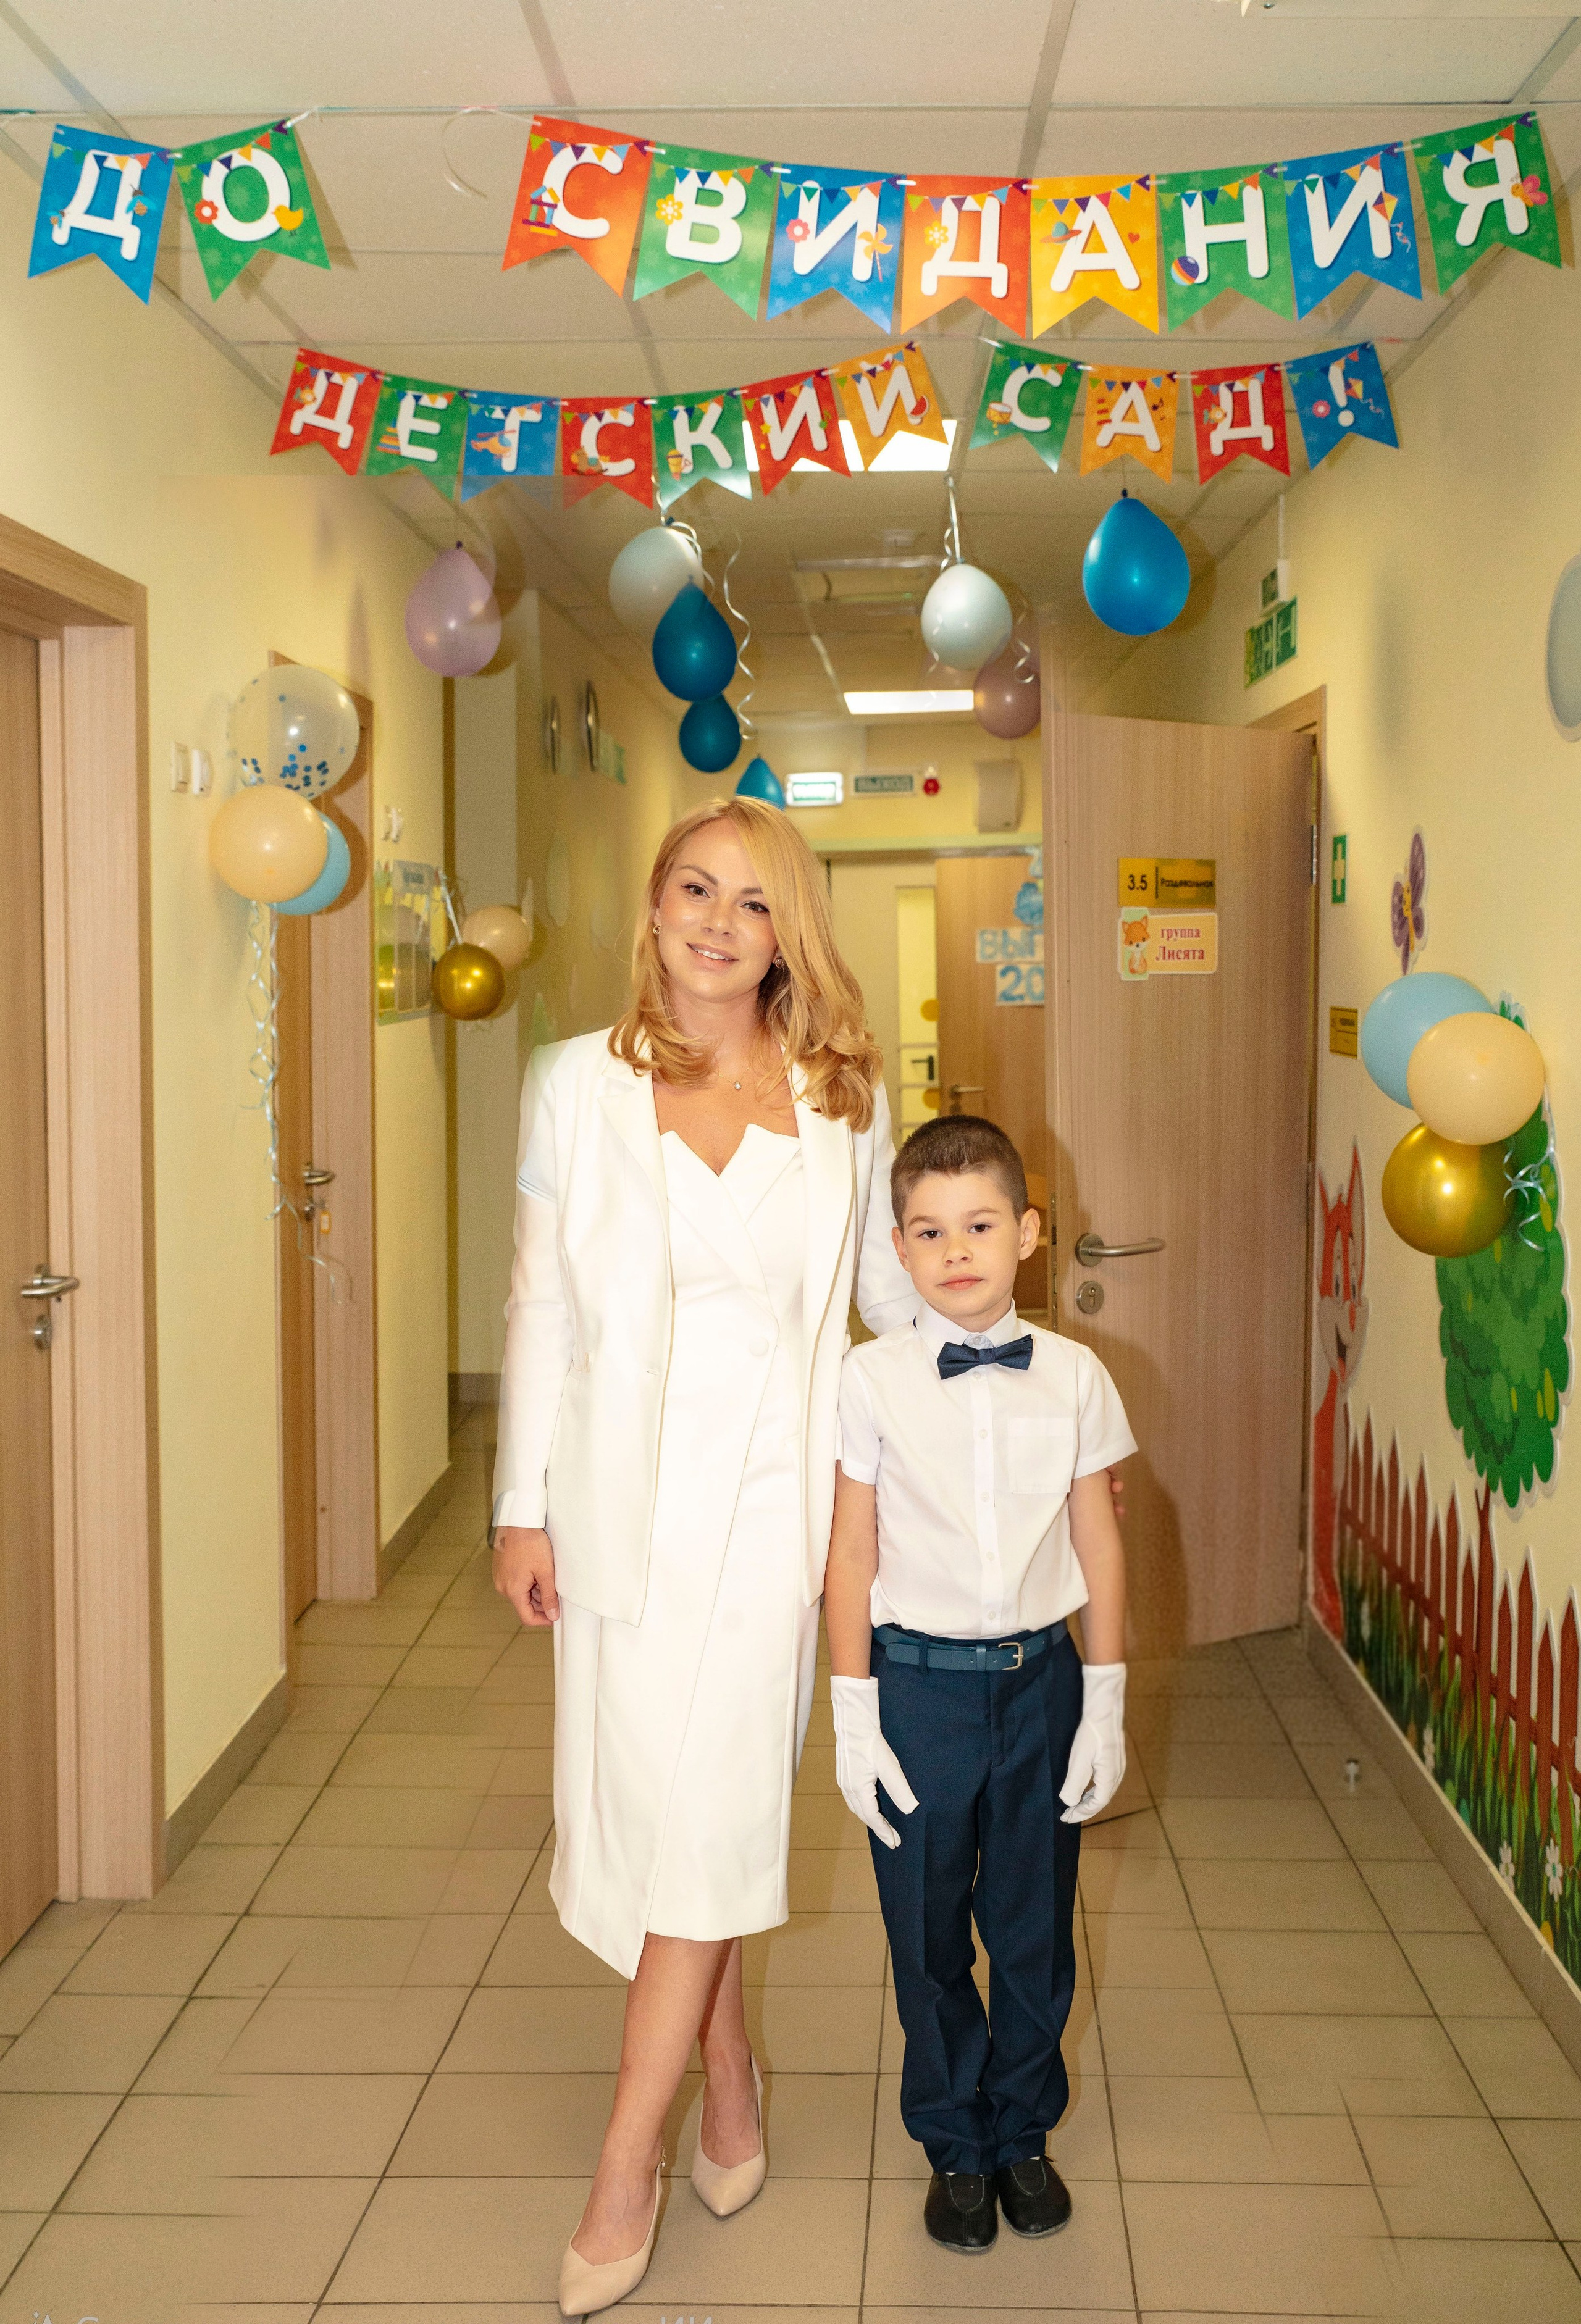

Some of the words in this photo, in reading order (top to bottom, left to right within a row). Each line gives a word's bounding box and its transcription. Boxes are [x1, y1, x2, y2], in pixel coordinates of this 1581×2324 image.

[51, 148, 290, 261] ДО
[542, 138, 1529, 298] СВИДАНИЯ
[290, 353, 921, 477] ДЕТСКИЙ
[1002, 362, 1354, 456] САД!
[1128, 874, 1148, 891] 3.5
[1160, 928, 1201, 942] группа
[1156, 946, 1205, 961] Лисята
